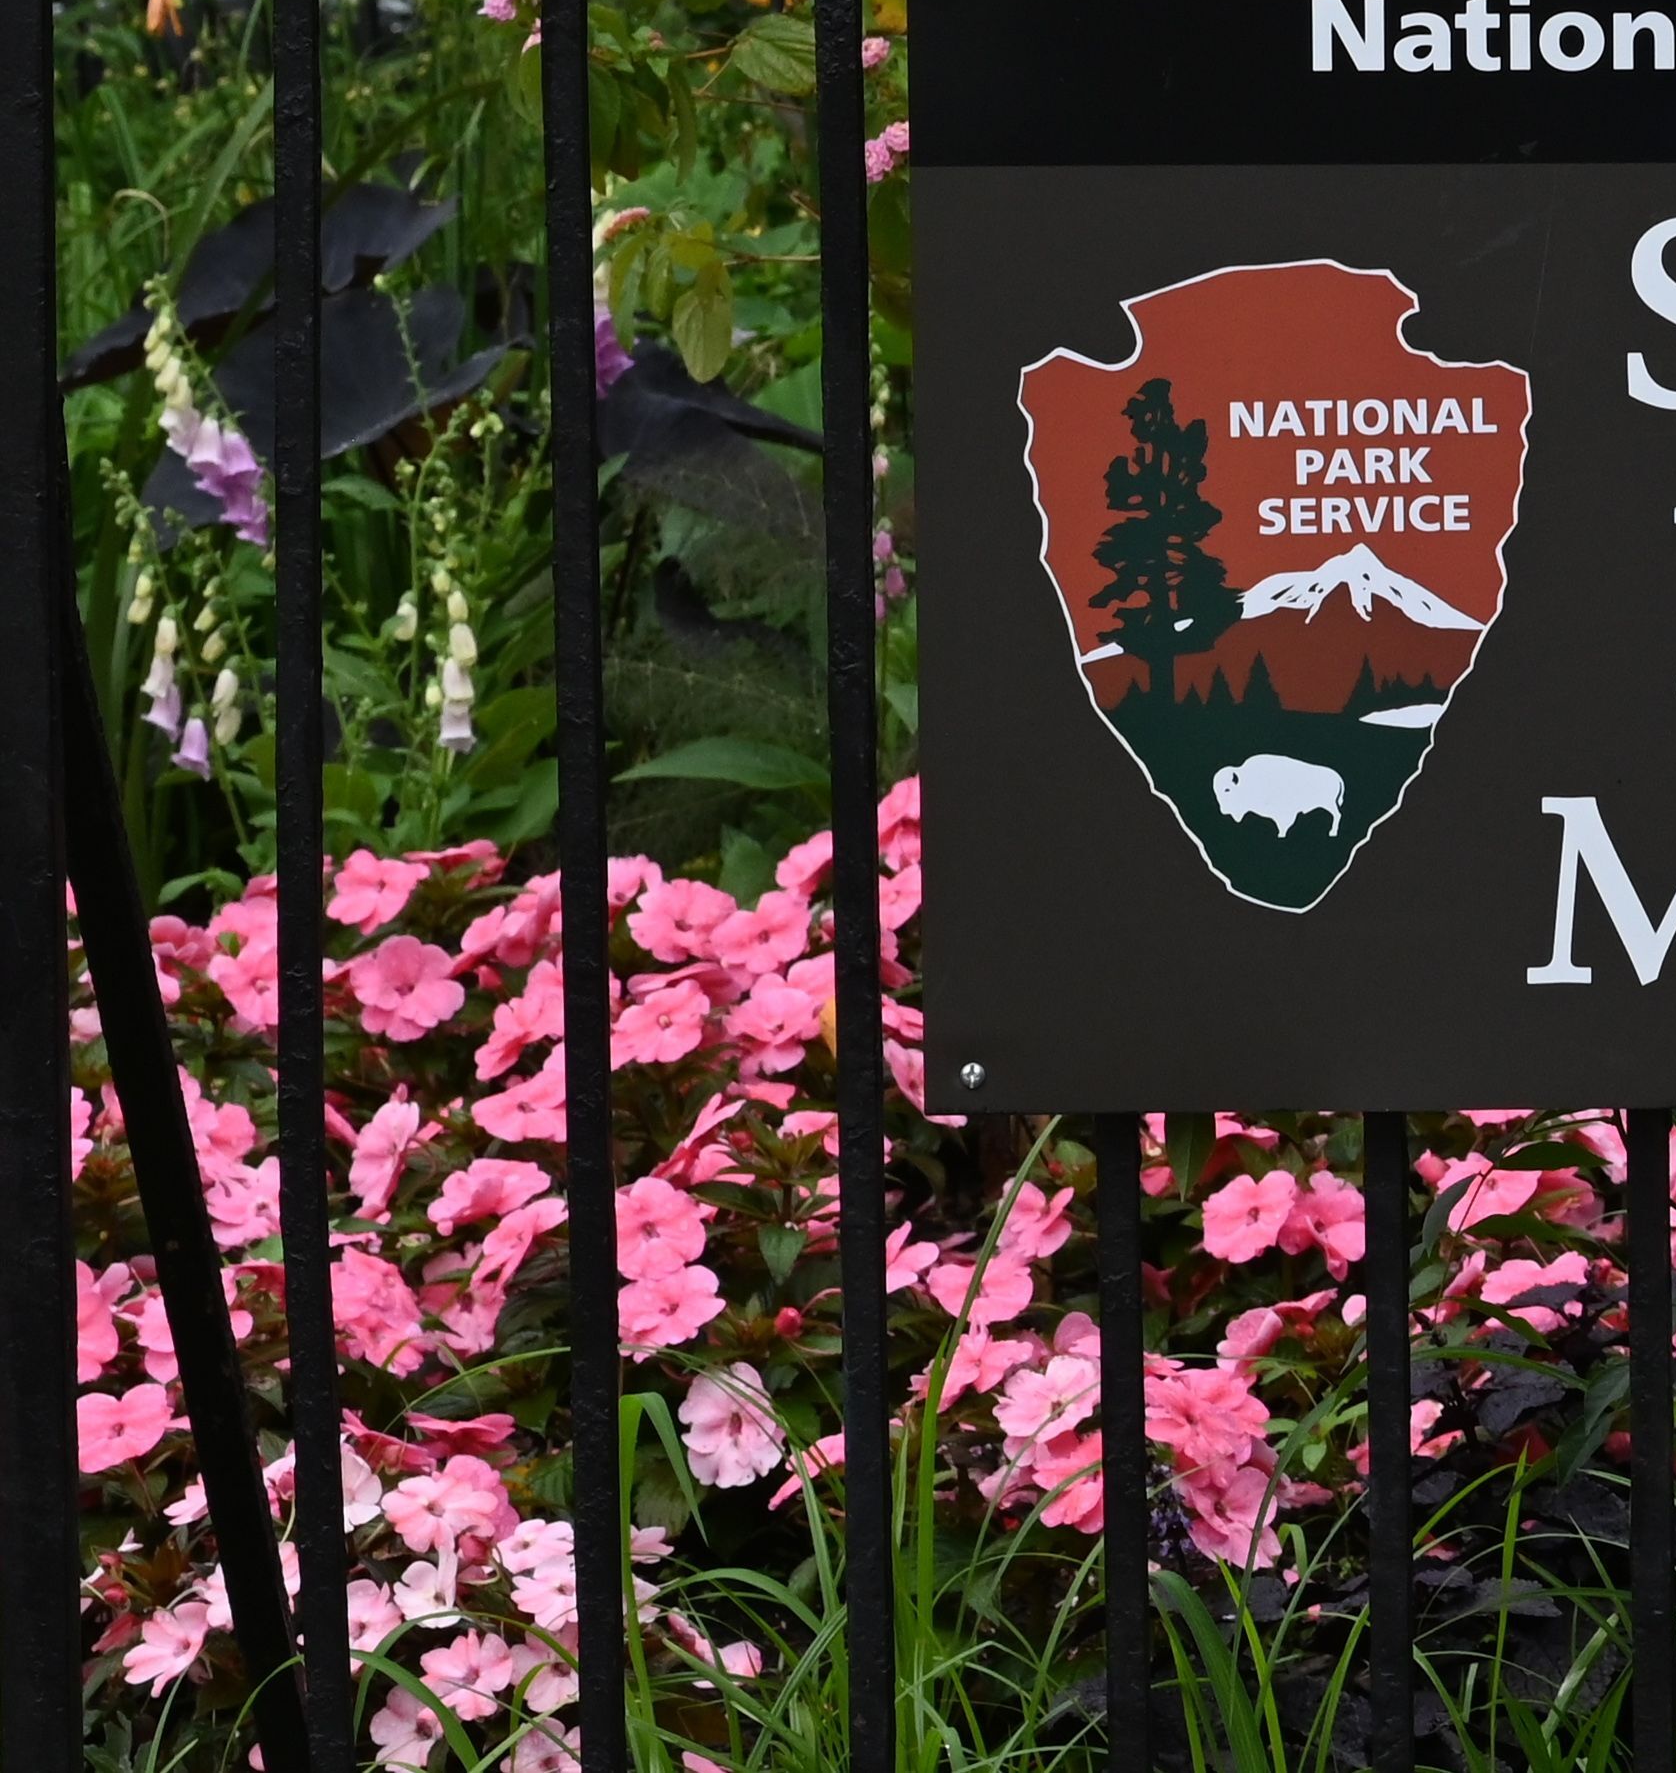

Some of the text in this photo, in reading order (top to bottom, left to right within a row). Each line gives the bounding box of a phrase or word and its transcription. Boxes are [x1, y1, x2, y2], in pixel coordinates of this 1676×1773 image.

[1229, 397, 1498, 438] NATIONAL
[1295, 446, 1433, 486] PARK
[1258, 494, 1471, 536] SERVICE
